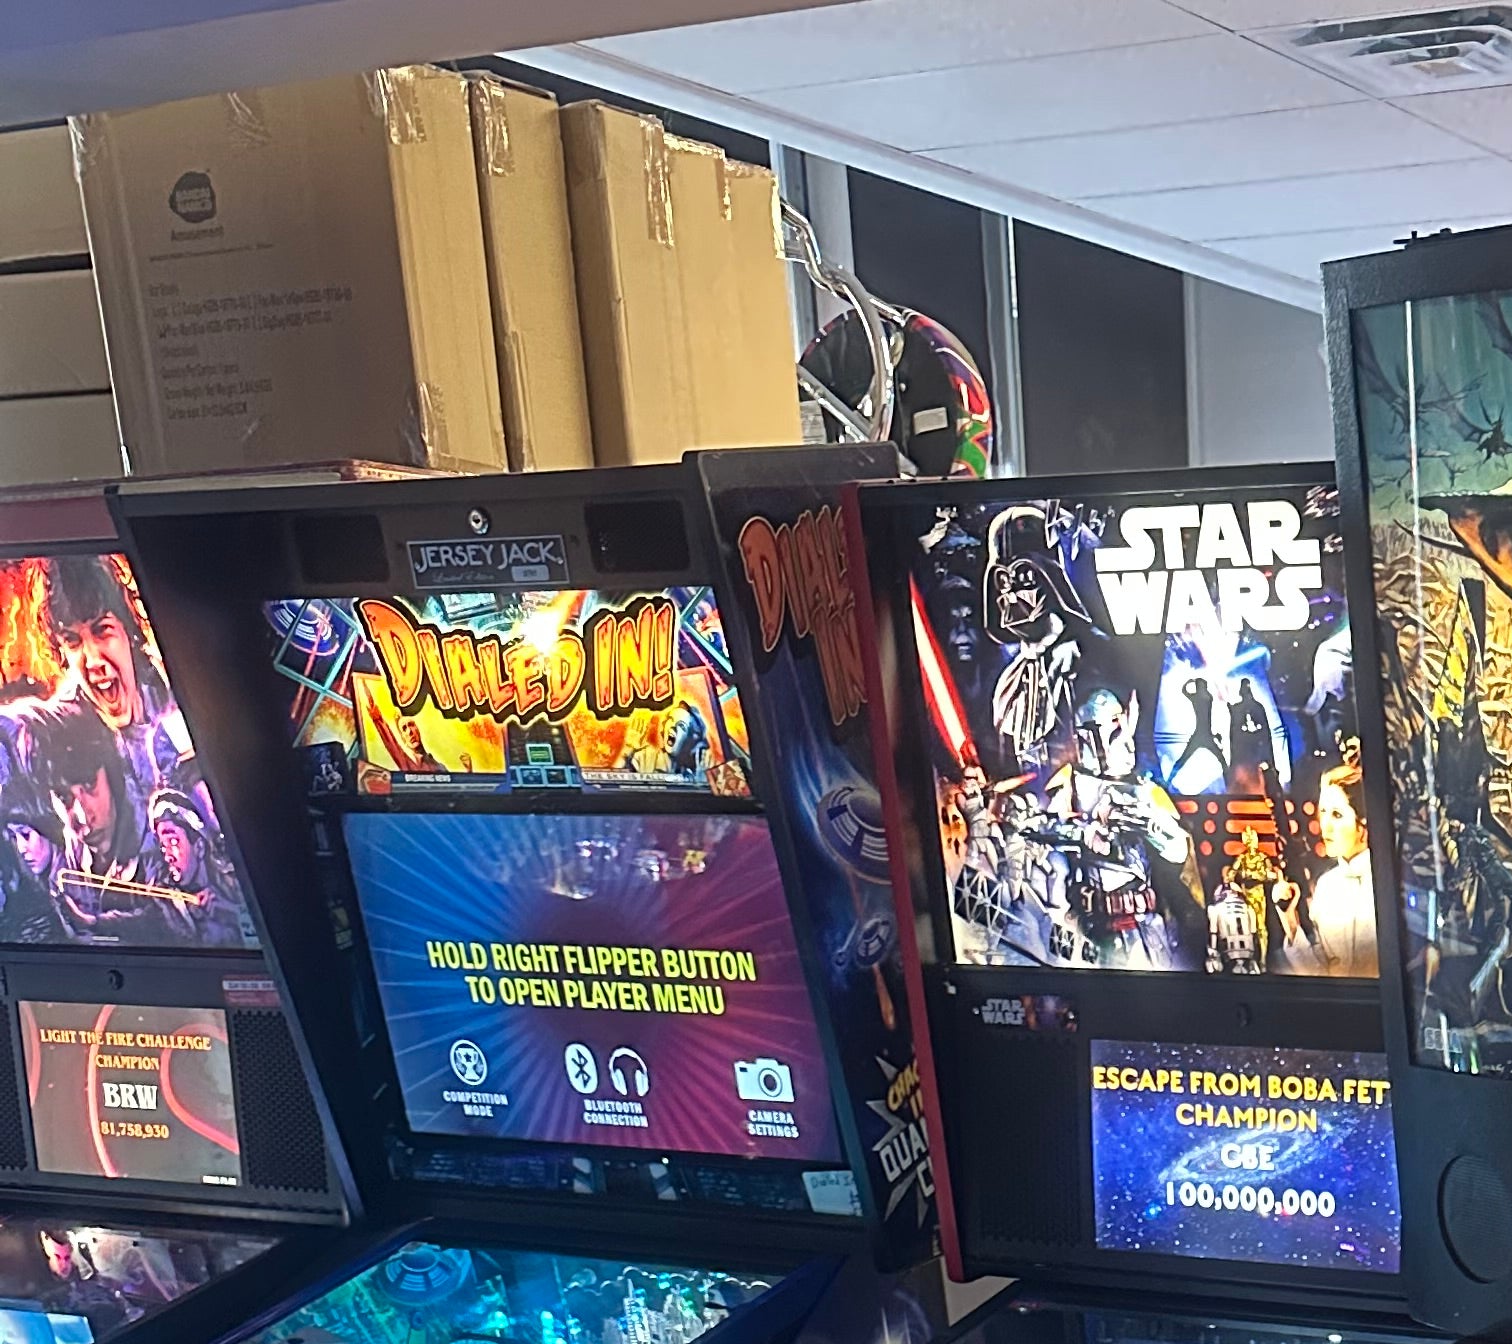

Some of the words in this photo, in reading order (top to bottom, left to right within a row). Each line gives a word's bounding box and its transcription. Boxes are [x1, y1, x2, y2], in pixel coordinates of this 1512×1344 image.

[1094, 501, 1322, 572] STAR
[415, 543, 494, 573] JERSEY
[498, 541, 564, 570] JACK
[1098, 566, 1322, 635] WARS
[359, 600, 584, 716] DIALED
[595, 602, 676, 713] IN!
[427, 940, 490, 972] HOLD
[493, 944, 561, 975] RIGHT
[565, 947, 659, 978] FLIPPER
[662, 949, 756, 982] BUTTON
[465, 974, 495, 1003] TO
[500, 975, 562, 1006] OPEN
[566, 978, 651, 1012] PLAYER
[653, 982, 725, 1015] MENU
[980, 997, 1023, 1013] STAR
[982, 1010, 1026, 1026] WARS
[40, 1028, 77, 1044] LIGHT
[79, 1030, 103, 1045] THE
[106, 1032, 134, 1047] FIRE
[136, 1033, 212, 1051] CHALLENGE
[95, 1054, 160, 1071] CHAMPION
[102, 1082, 159, 1110] BRW
[1092, 1066, 1185, 1094] ESCAPE
[1189, 1070, 1261, 1098] FROM
[1267, 1075, 1338, 1102] BOBA
[1343, 1079, 1391, 1106] FET
[443, 1090, 508, 1106] COMPETITION
[583, 1098, 643, 1114] BLUETOOTH
[463, 1103, 494, 1118] MODE
[583, 1111, 649, 1128] CONNECTION
[748, 1109, 795, 1124] CAMERA
[1176, 1103, 1318, 1133] CHAMPION
[100, 1121, 170, 1140] 81,758,930
[747, 1122, 800, 1139] SETTINGS
[1166, 1181, 1337, 1218] 100,000,000
